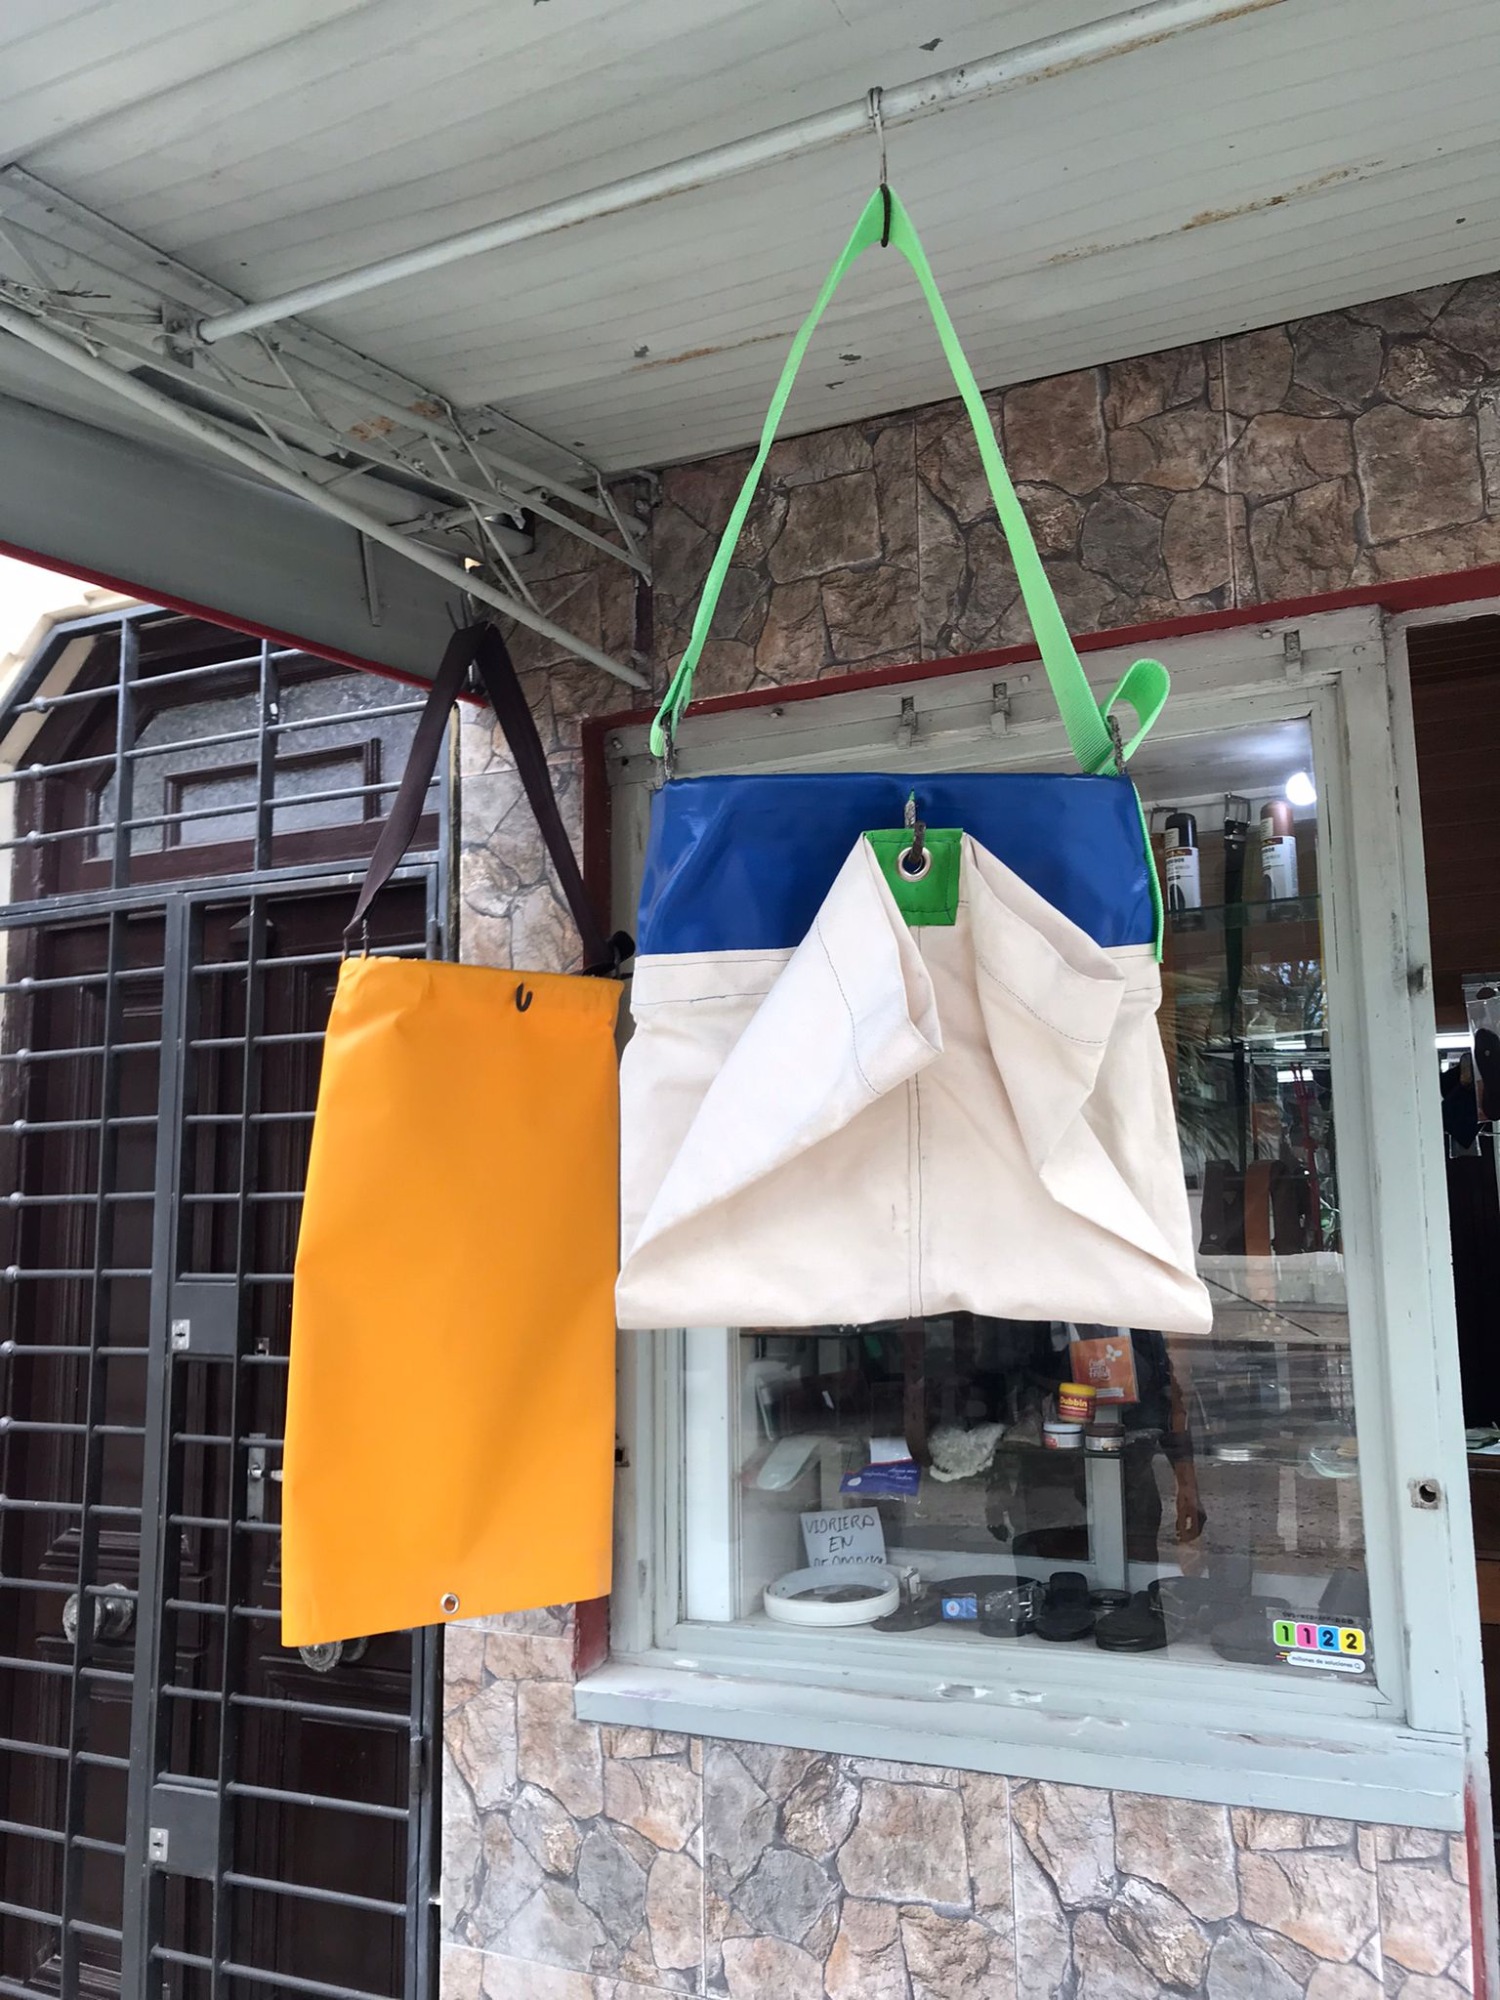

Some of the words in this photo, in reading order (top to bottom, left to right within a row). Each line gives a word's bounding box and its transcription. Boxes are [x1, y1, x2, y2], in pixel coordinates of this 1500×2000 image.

[805, 1514, 875, 1534] VIDRIERA
[829, 1535, 854, 1553] EN
[1325, 1660, 1353, 1668] soluciones
